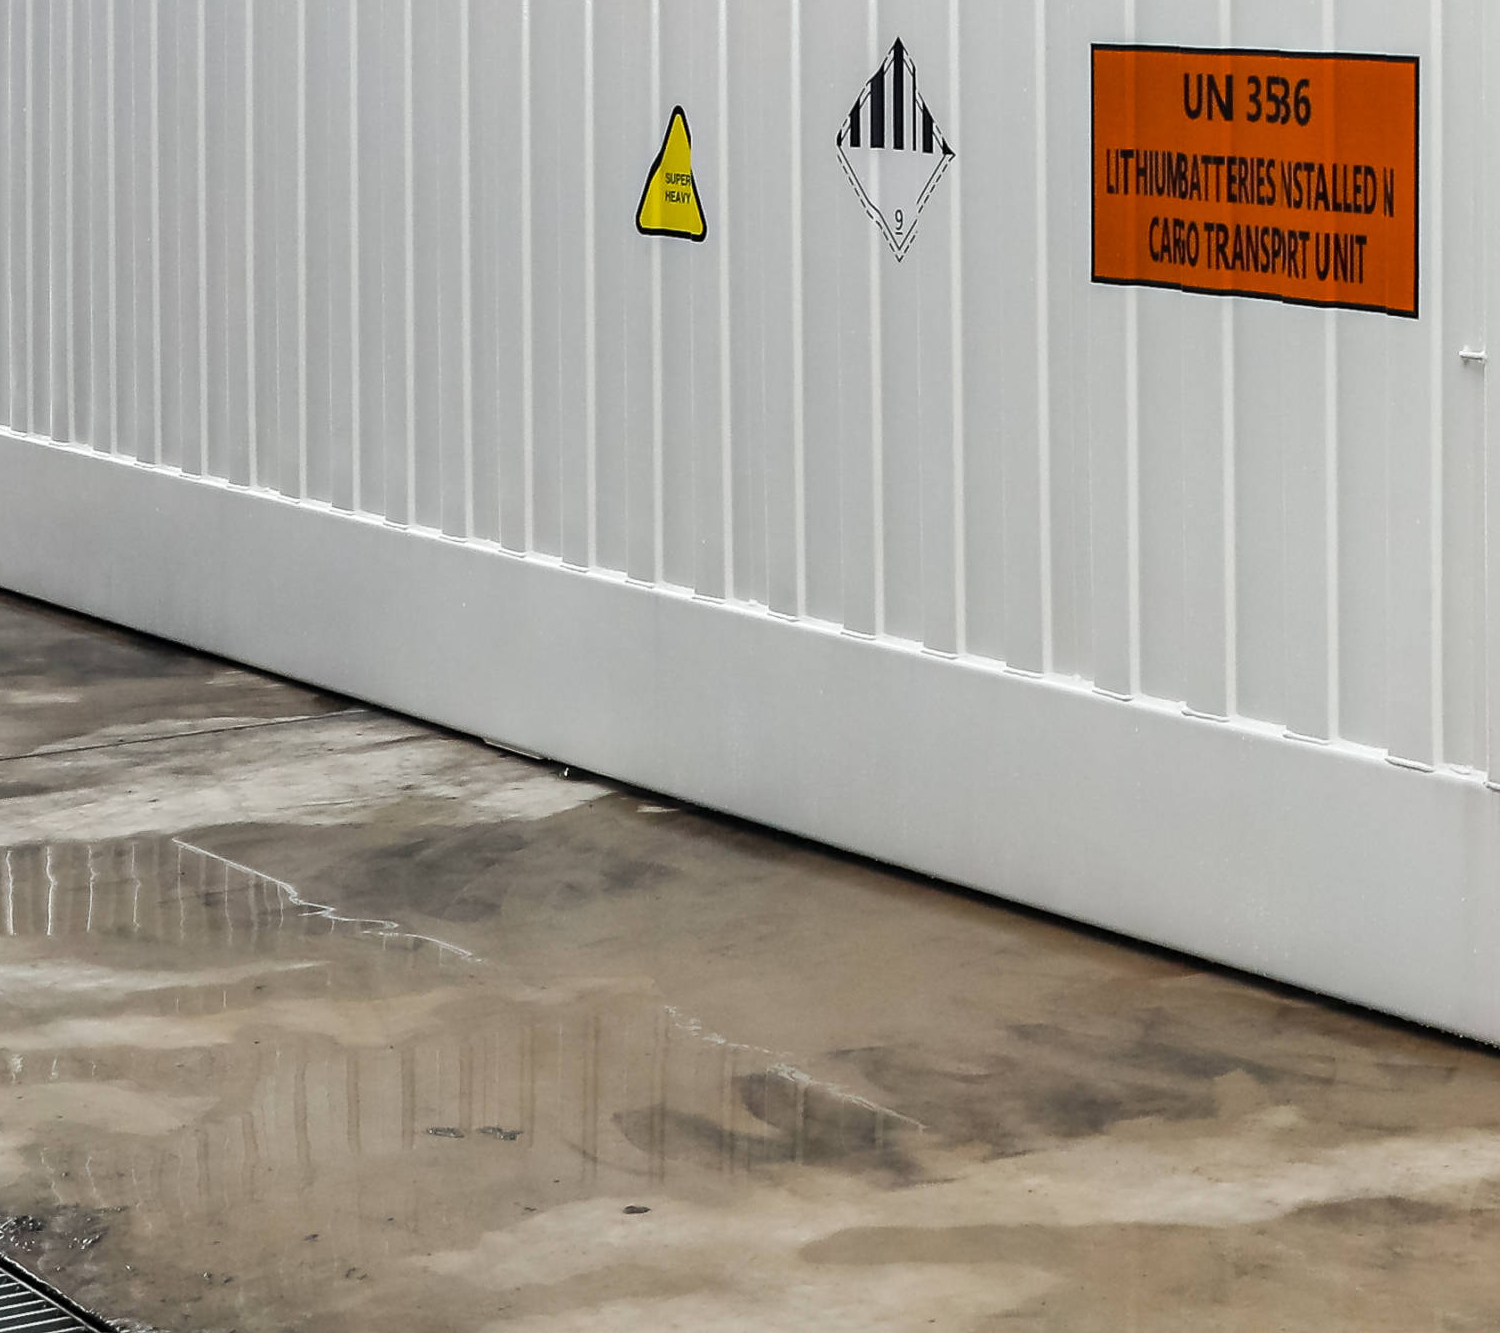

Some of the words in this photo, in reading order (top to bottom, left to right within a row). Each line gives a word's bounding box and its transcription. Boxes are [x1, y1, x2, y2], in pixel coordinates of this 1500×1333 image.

[1183, 72, 1234, 122] UN
[1246, 75, 1312, 127] 3536
[664, 171, 691, 187] SUPER
[664, 189, 691, 204] HEAVY
[1280, 159, 1377, 215] NSTALLED
[894, 209, 904, 232] 9
[1314, 231, 1367, 285] UNIT
